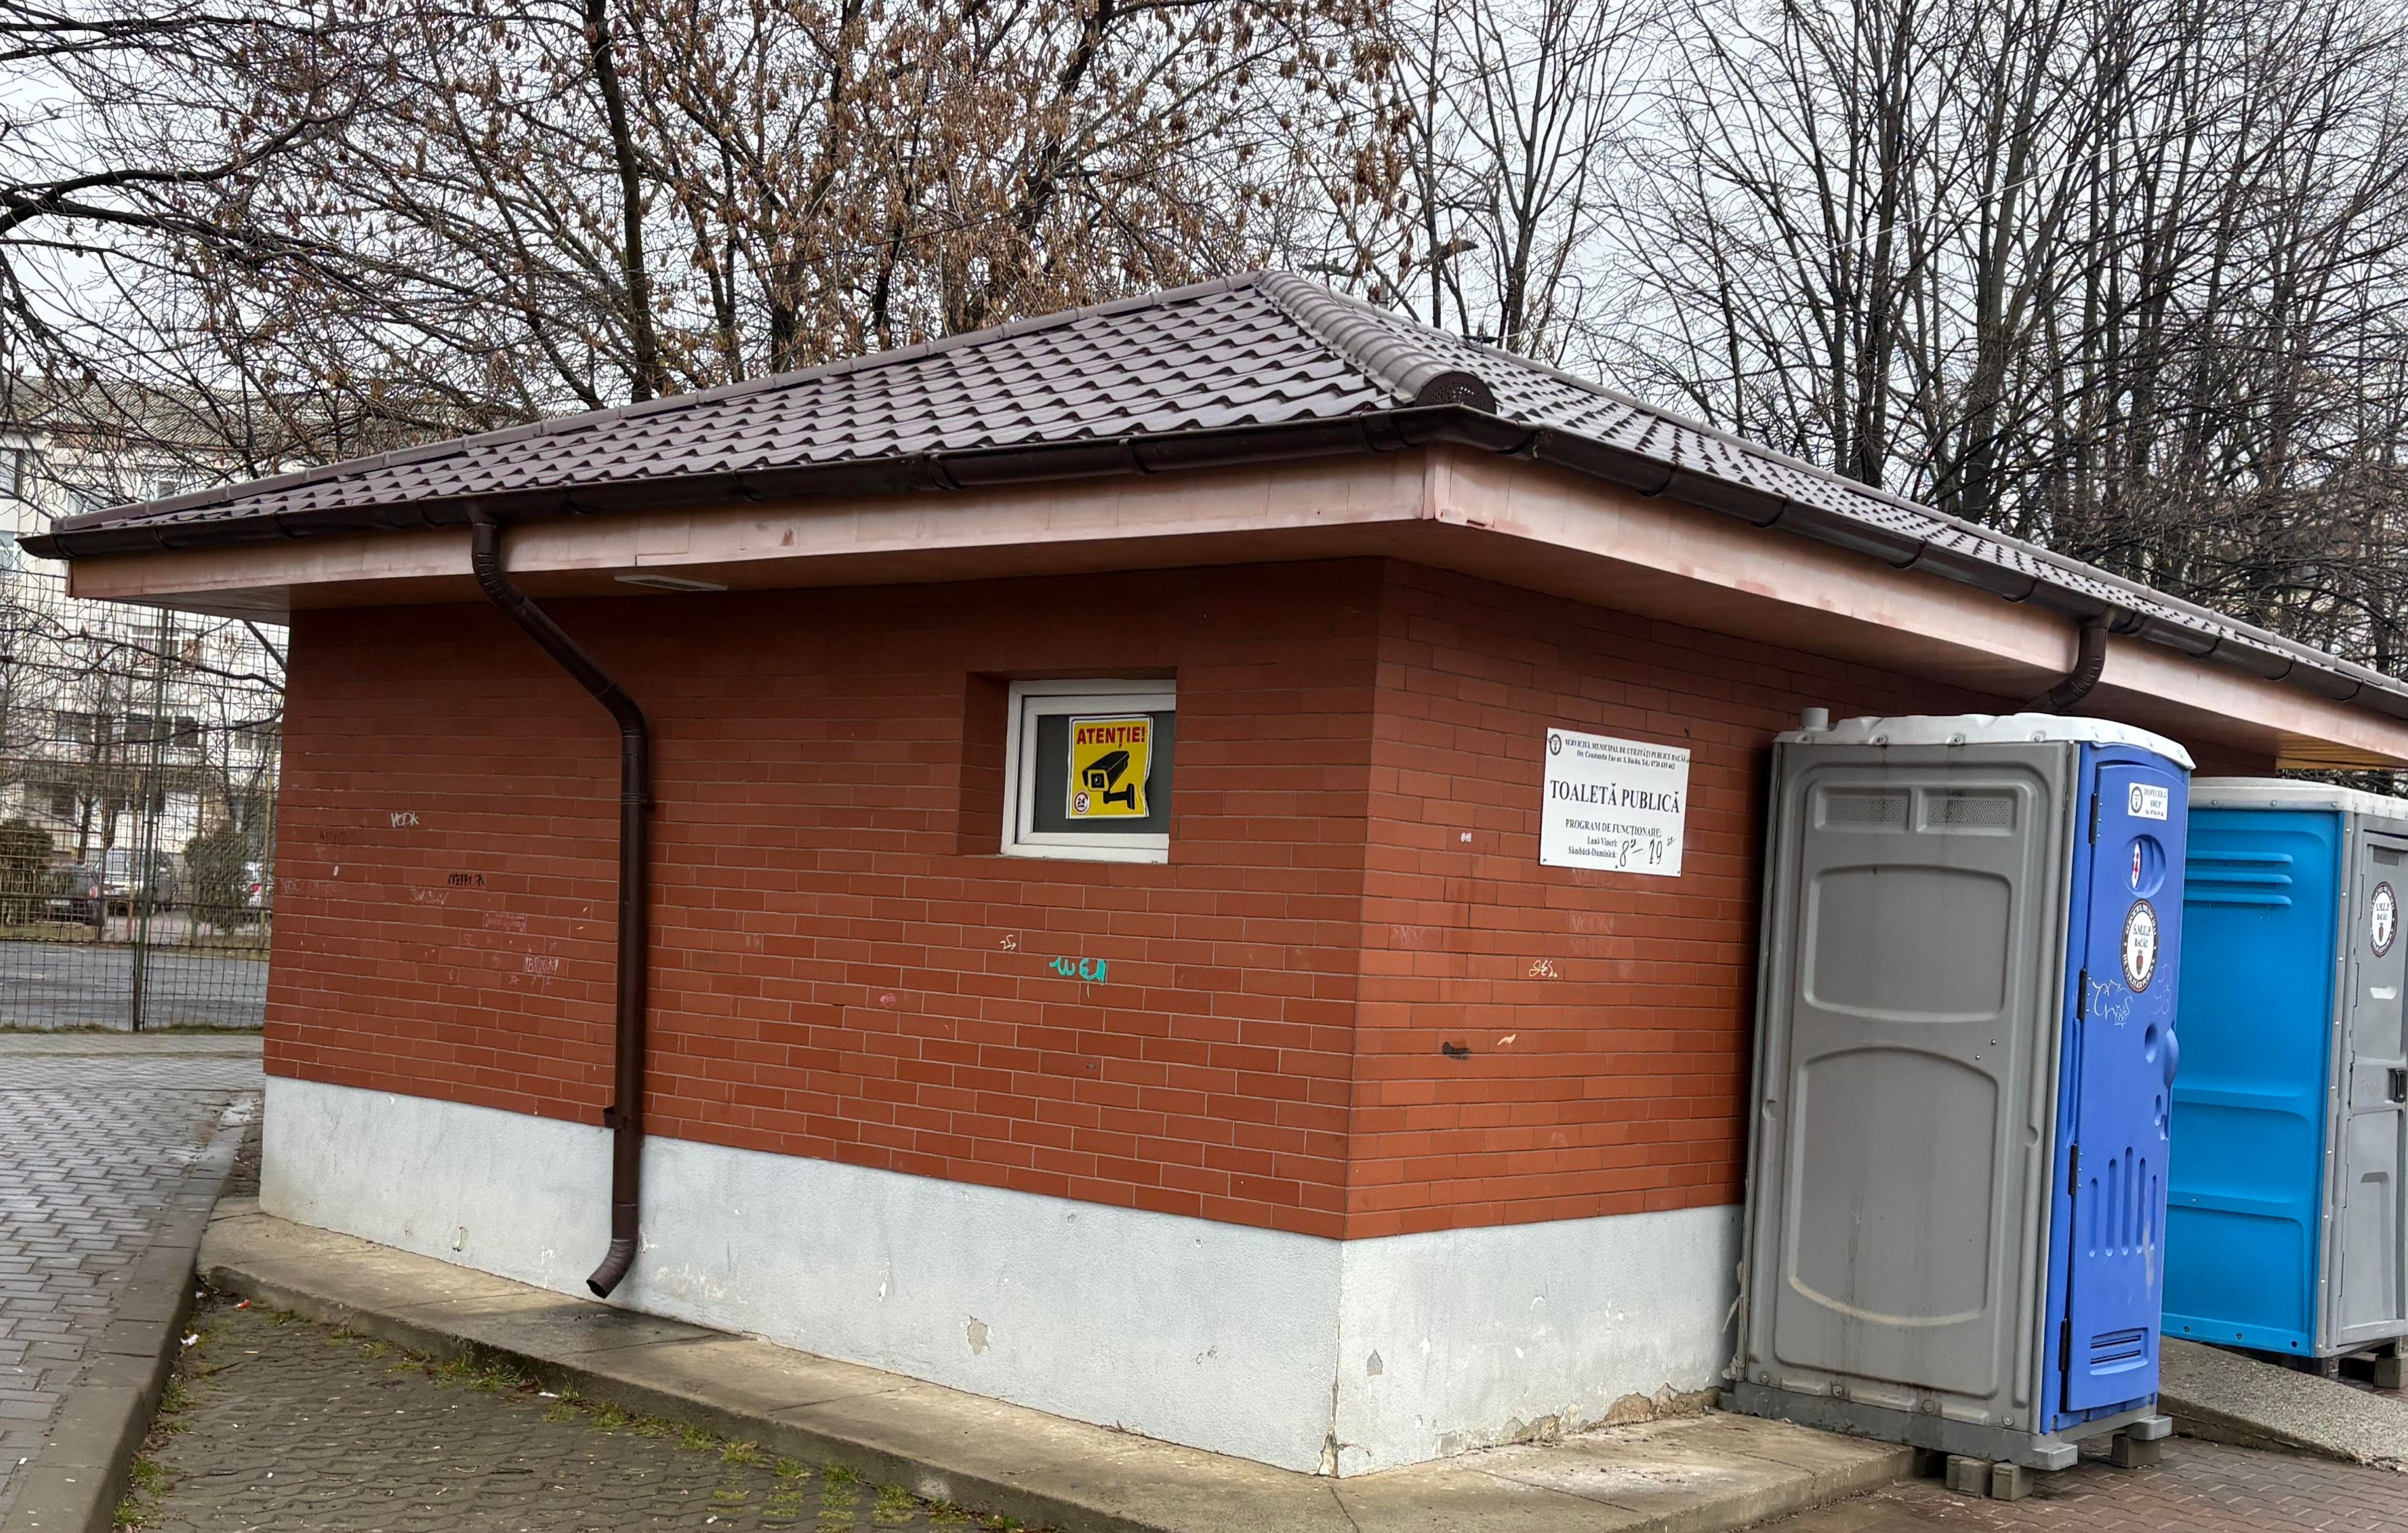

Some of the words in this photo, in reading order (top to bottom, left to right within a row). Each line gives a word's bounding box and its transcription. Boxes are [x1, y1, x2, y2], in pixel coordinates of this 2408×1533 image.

[1076, 726, 1146, 748] ATENȚIE!
[1550, 780, 1617, 806] TOALETĂ
[1621, 788, 1680, 813] PUBLICĂ
[1566, 819, 1600, 831] PROGRAM
[1602, 823, 1611, 832] DE
